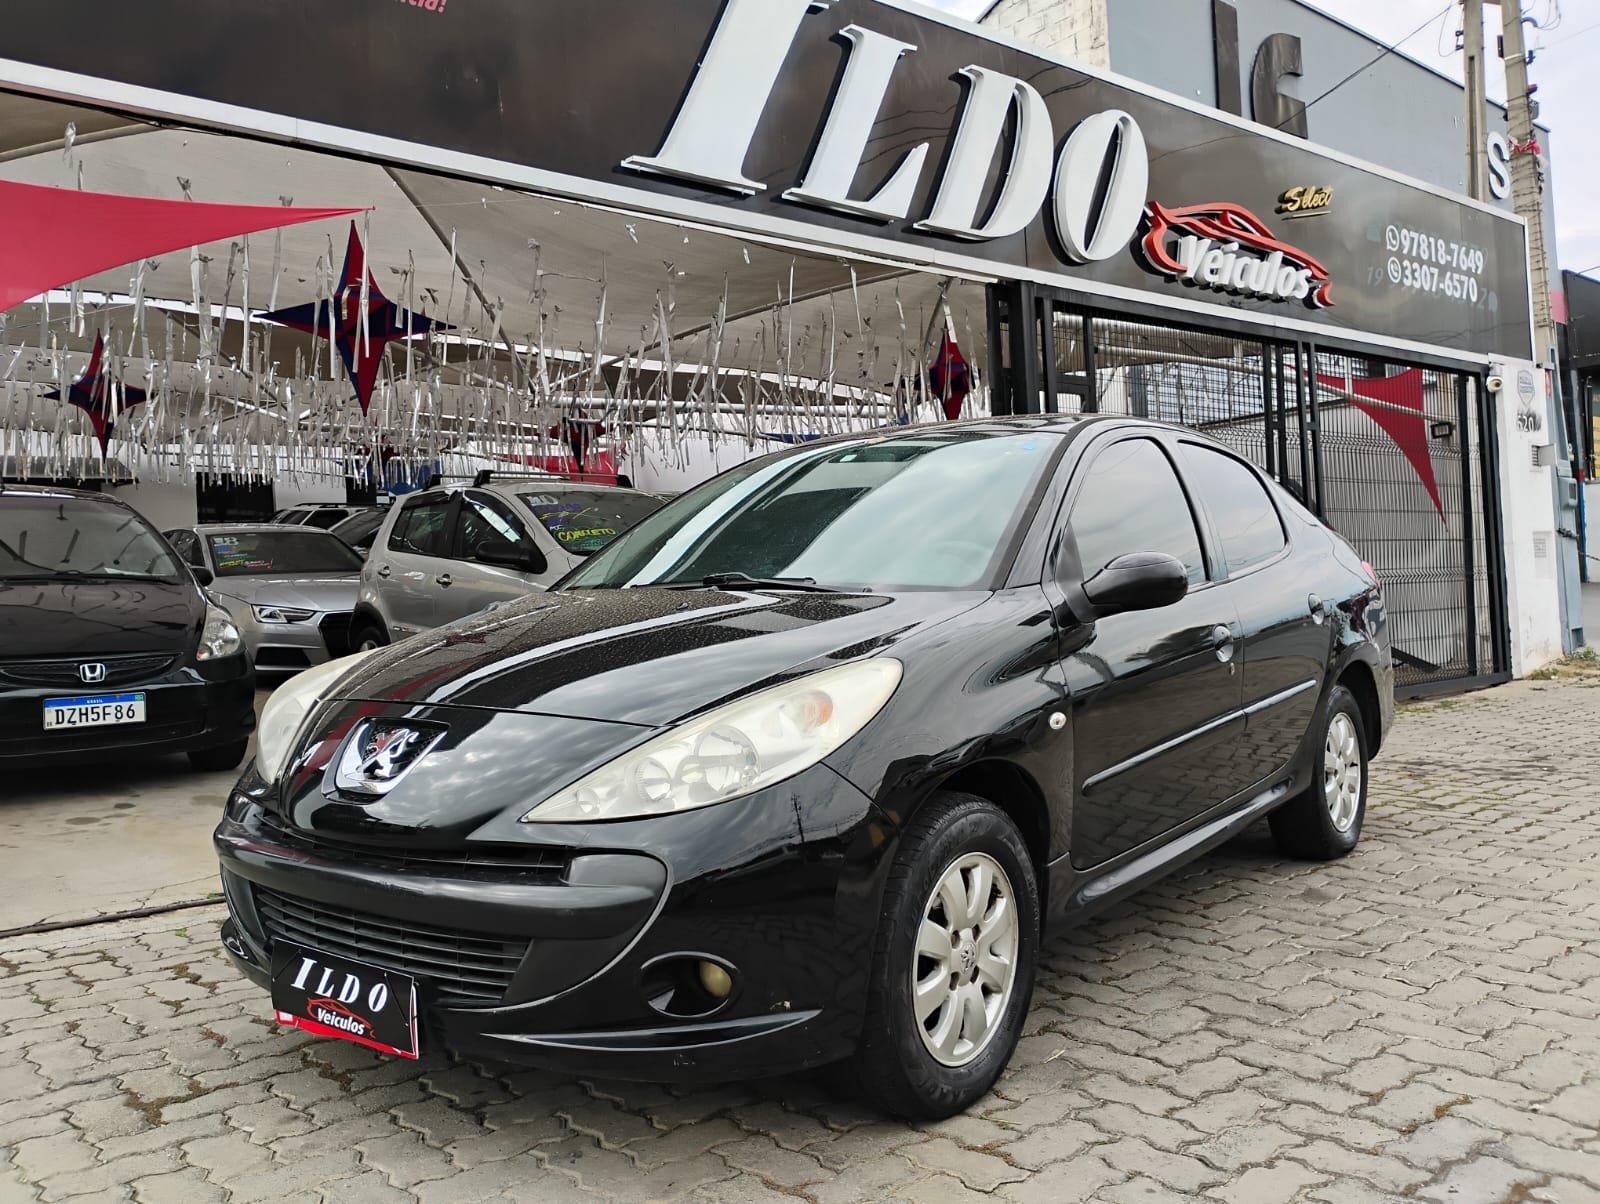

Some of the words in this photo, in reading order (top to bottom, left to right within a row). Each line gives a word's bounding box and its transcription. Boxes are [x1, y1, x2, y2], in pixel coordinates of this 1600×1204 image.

[620, 0, 1149, 264] ILDO
[1284, 185, 1334, 213] Select
[1400, 228, 1484, 275] 97818-7649
[1402, 259, 1478, 303] 3307-6570
[55, 703, 135, 726] DZH5F86
[290, 956, 388, 1013] ILDO
